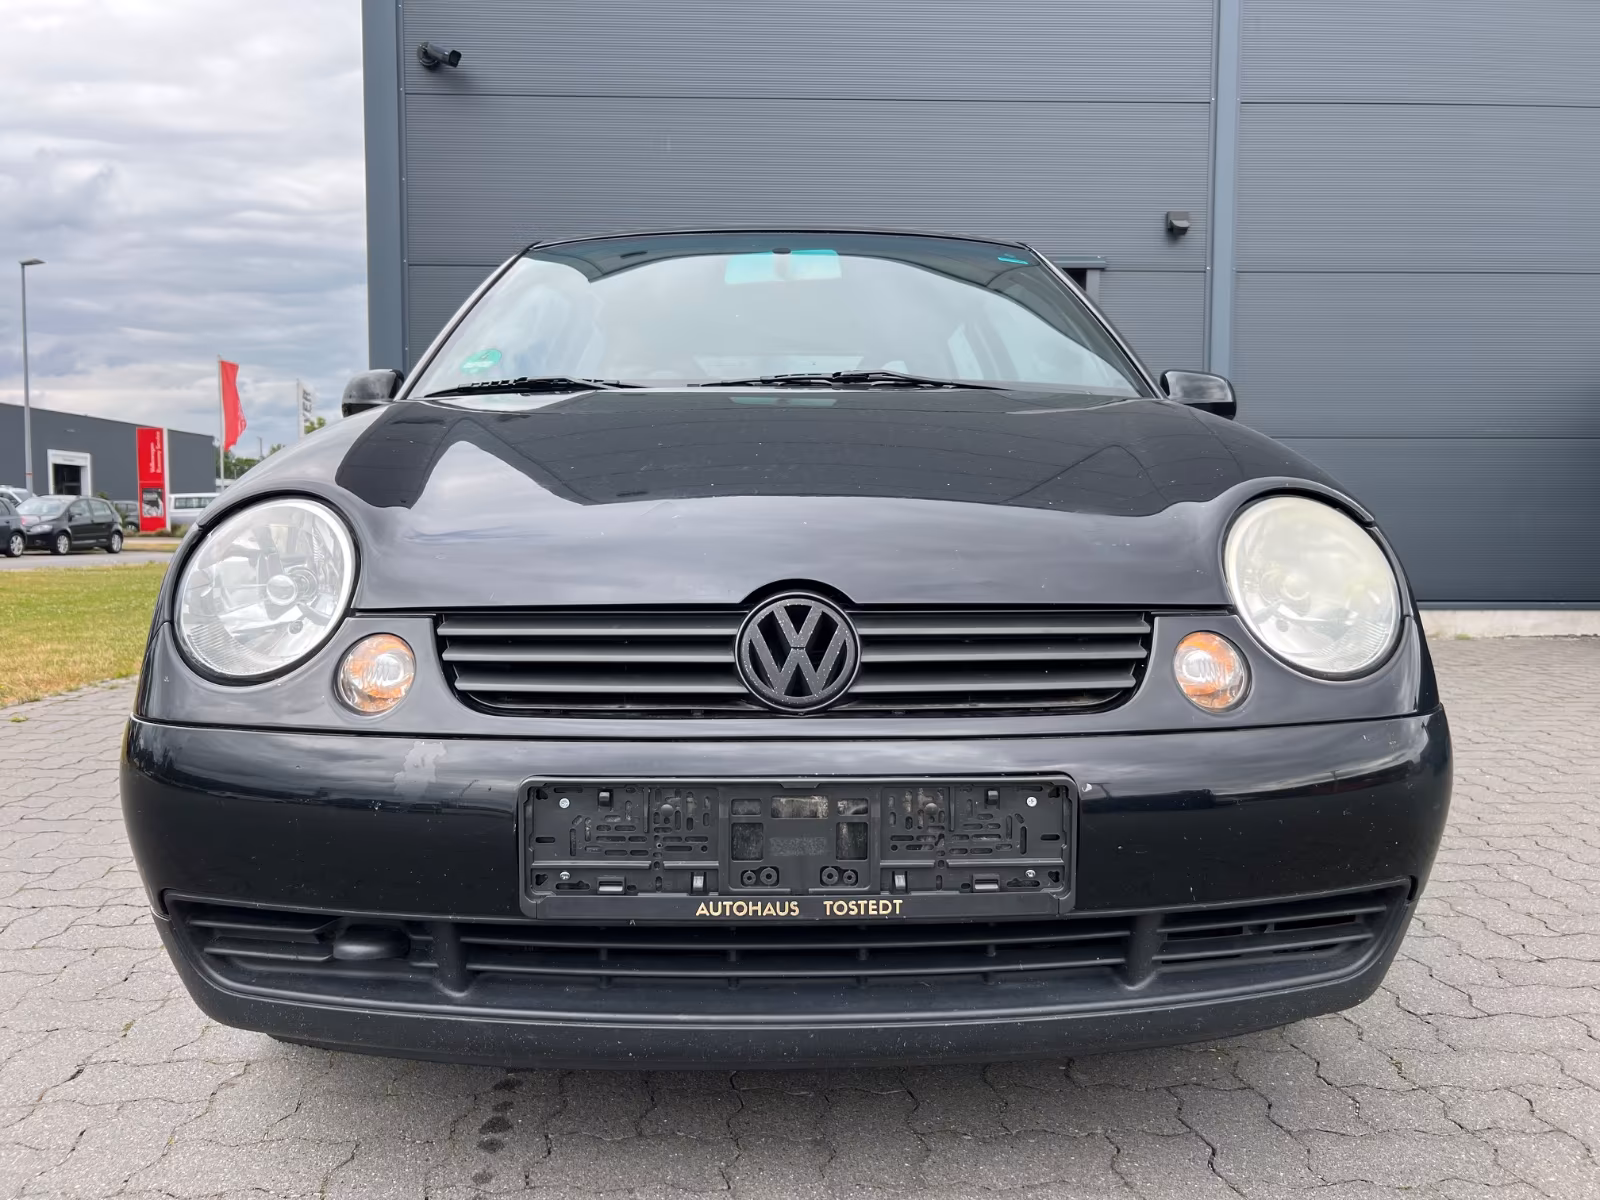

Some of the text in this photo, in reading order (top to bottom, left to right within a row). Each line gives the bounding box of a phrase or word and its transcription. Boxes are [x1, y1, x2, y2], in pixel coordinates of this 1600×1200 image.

[741, 598, 855, 704] VW
[695, 900, 903, 916] AUTOHAUS TOSTEDT
